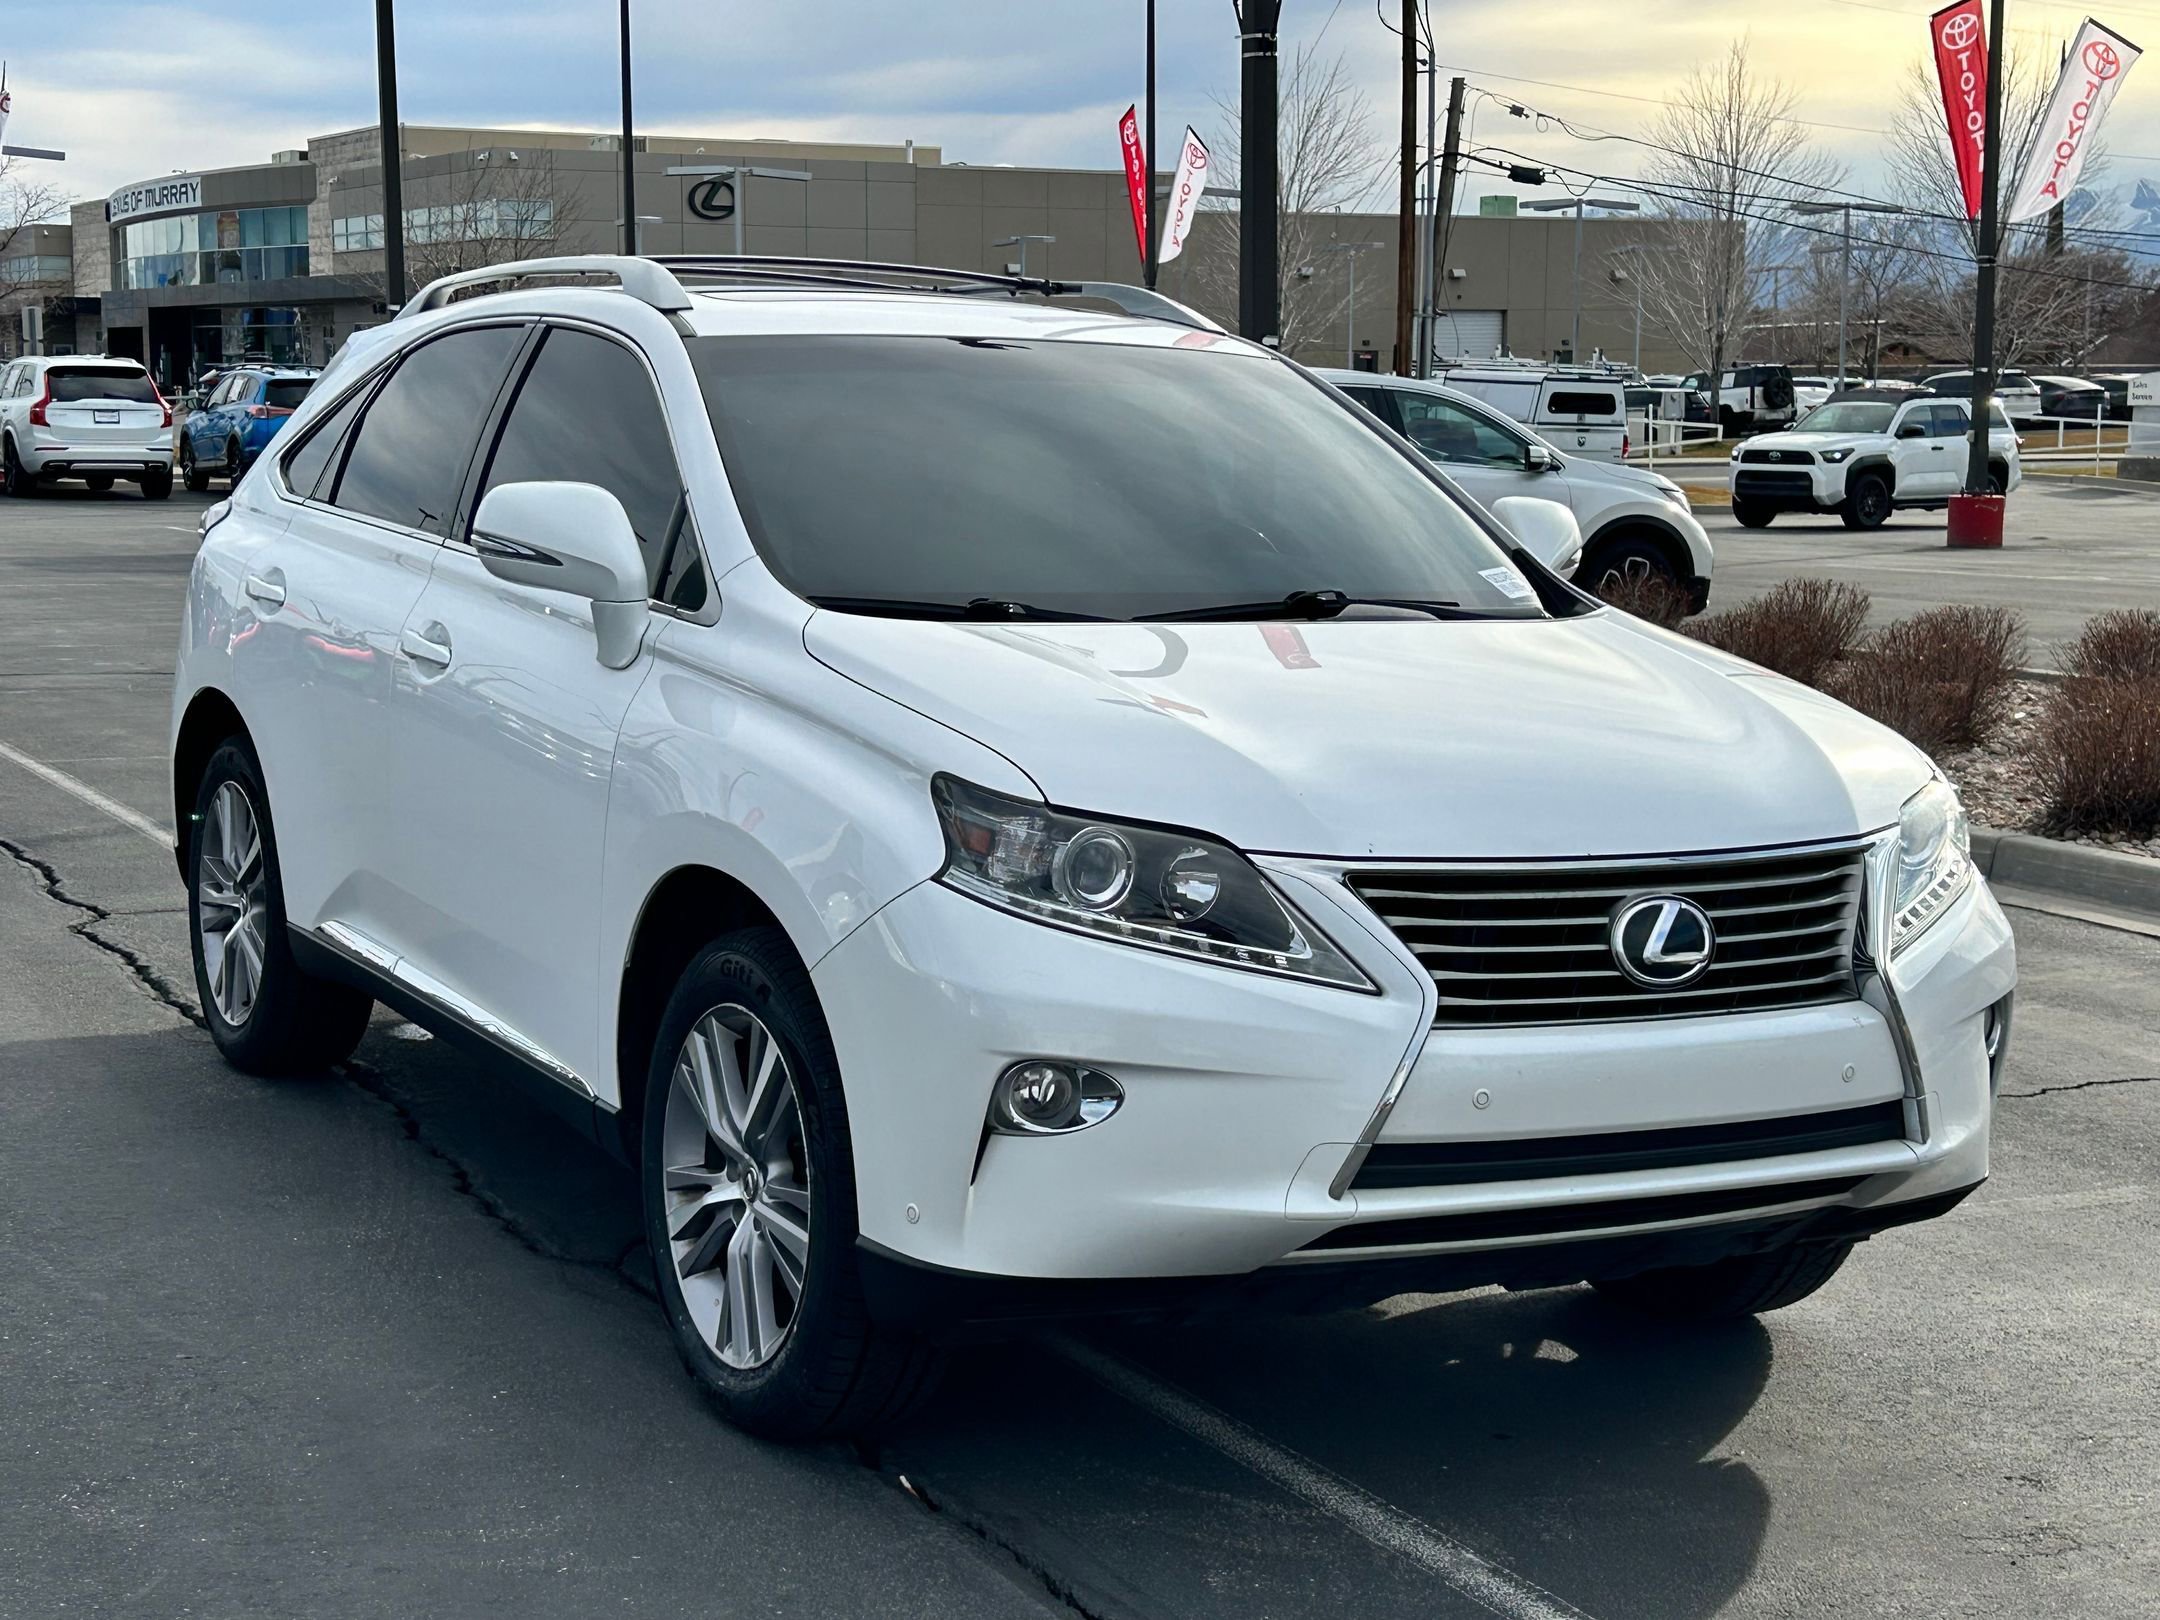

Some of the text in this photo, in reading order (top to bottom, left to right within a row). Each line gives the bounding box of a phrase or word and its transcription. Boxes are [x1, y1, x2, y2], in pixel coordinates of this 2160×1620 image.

[2040, 80, 2099, 199] TOYOTA
[131, 190, 143, 212] OF
[145, 181, 199, 208] MURRAY
